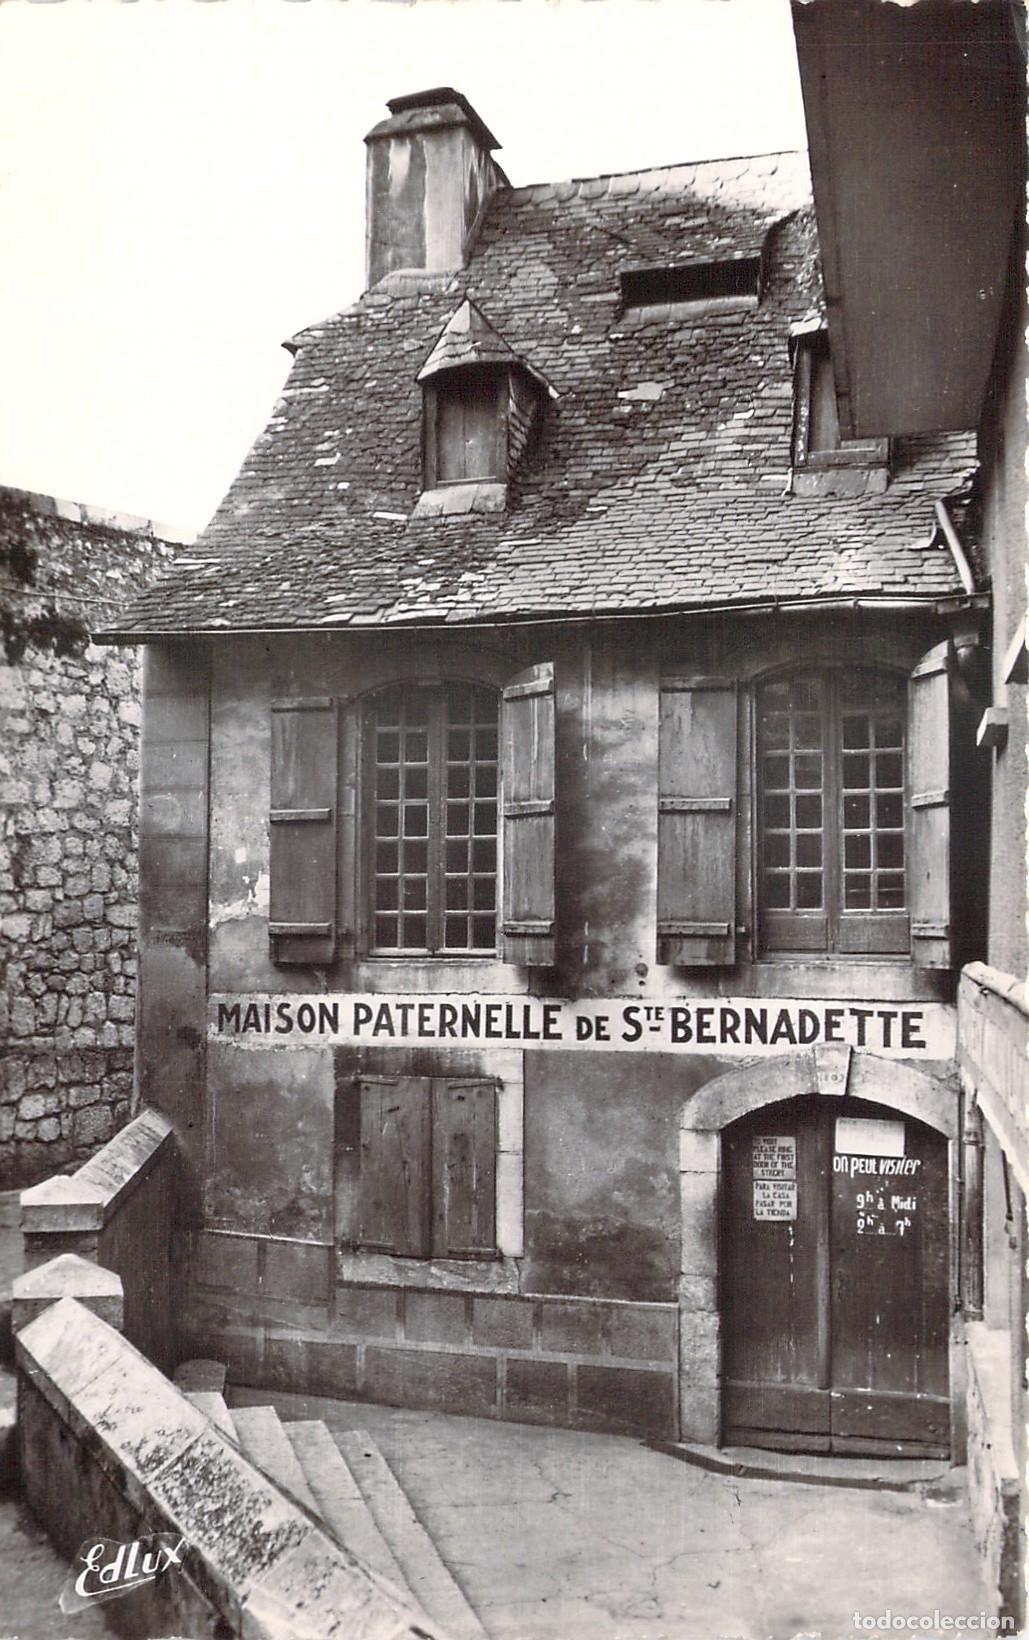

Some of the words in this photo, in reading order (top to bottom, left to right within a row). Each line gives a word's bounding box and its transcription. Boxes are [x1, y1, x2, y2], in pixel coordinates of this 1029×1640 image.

[218, 1002, 339, 1034] MAISON
[353, 1003, 563, 1040] PATERNELLE
[576, 1016, 611, 1041] DE
[671, 1007, 926, 1049] BERNADETTE
[755, 1182, 770, 1190] PARA
[773, 1191, 790, 1199] CASA
[755, 1200, 775, 1208] PASAR
[891, 1195, 917, 1212] Midi
